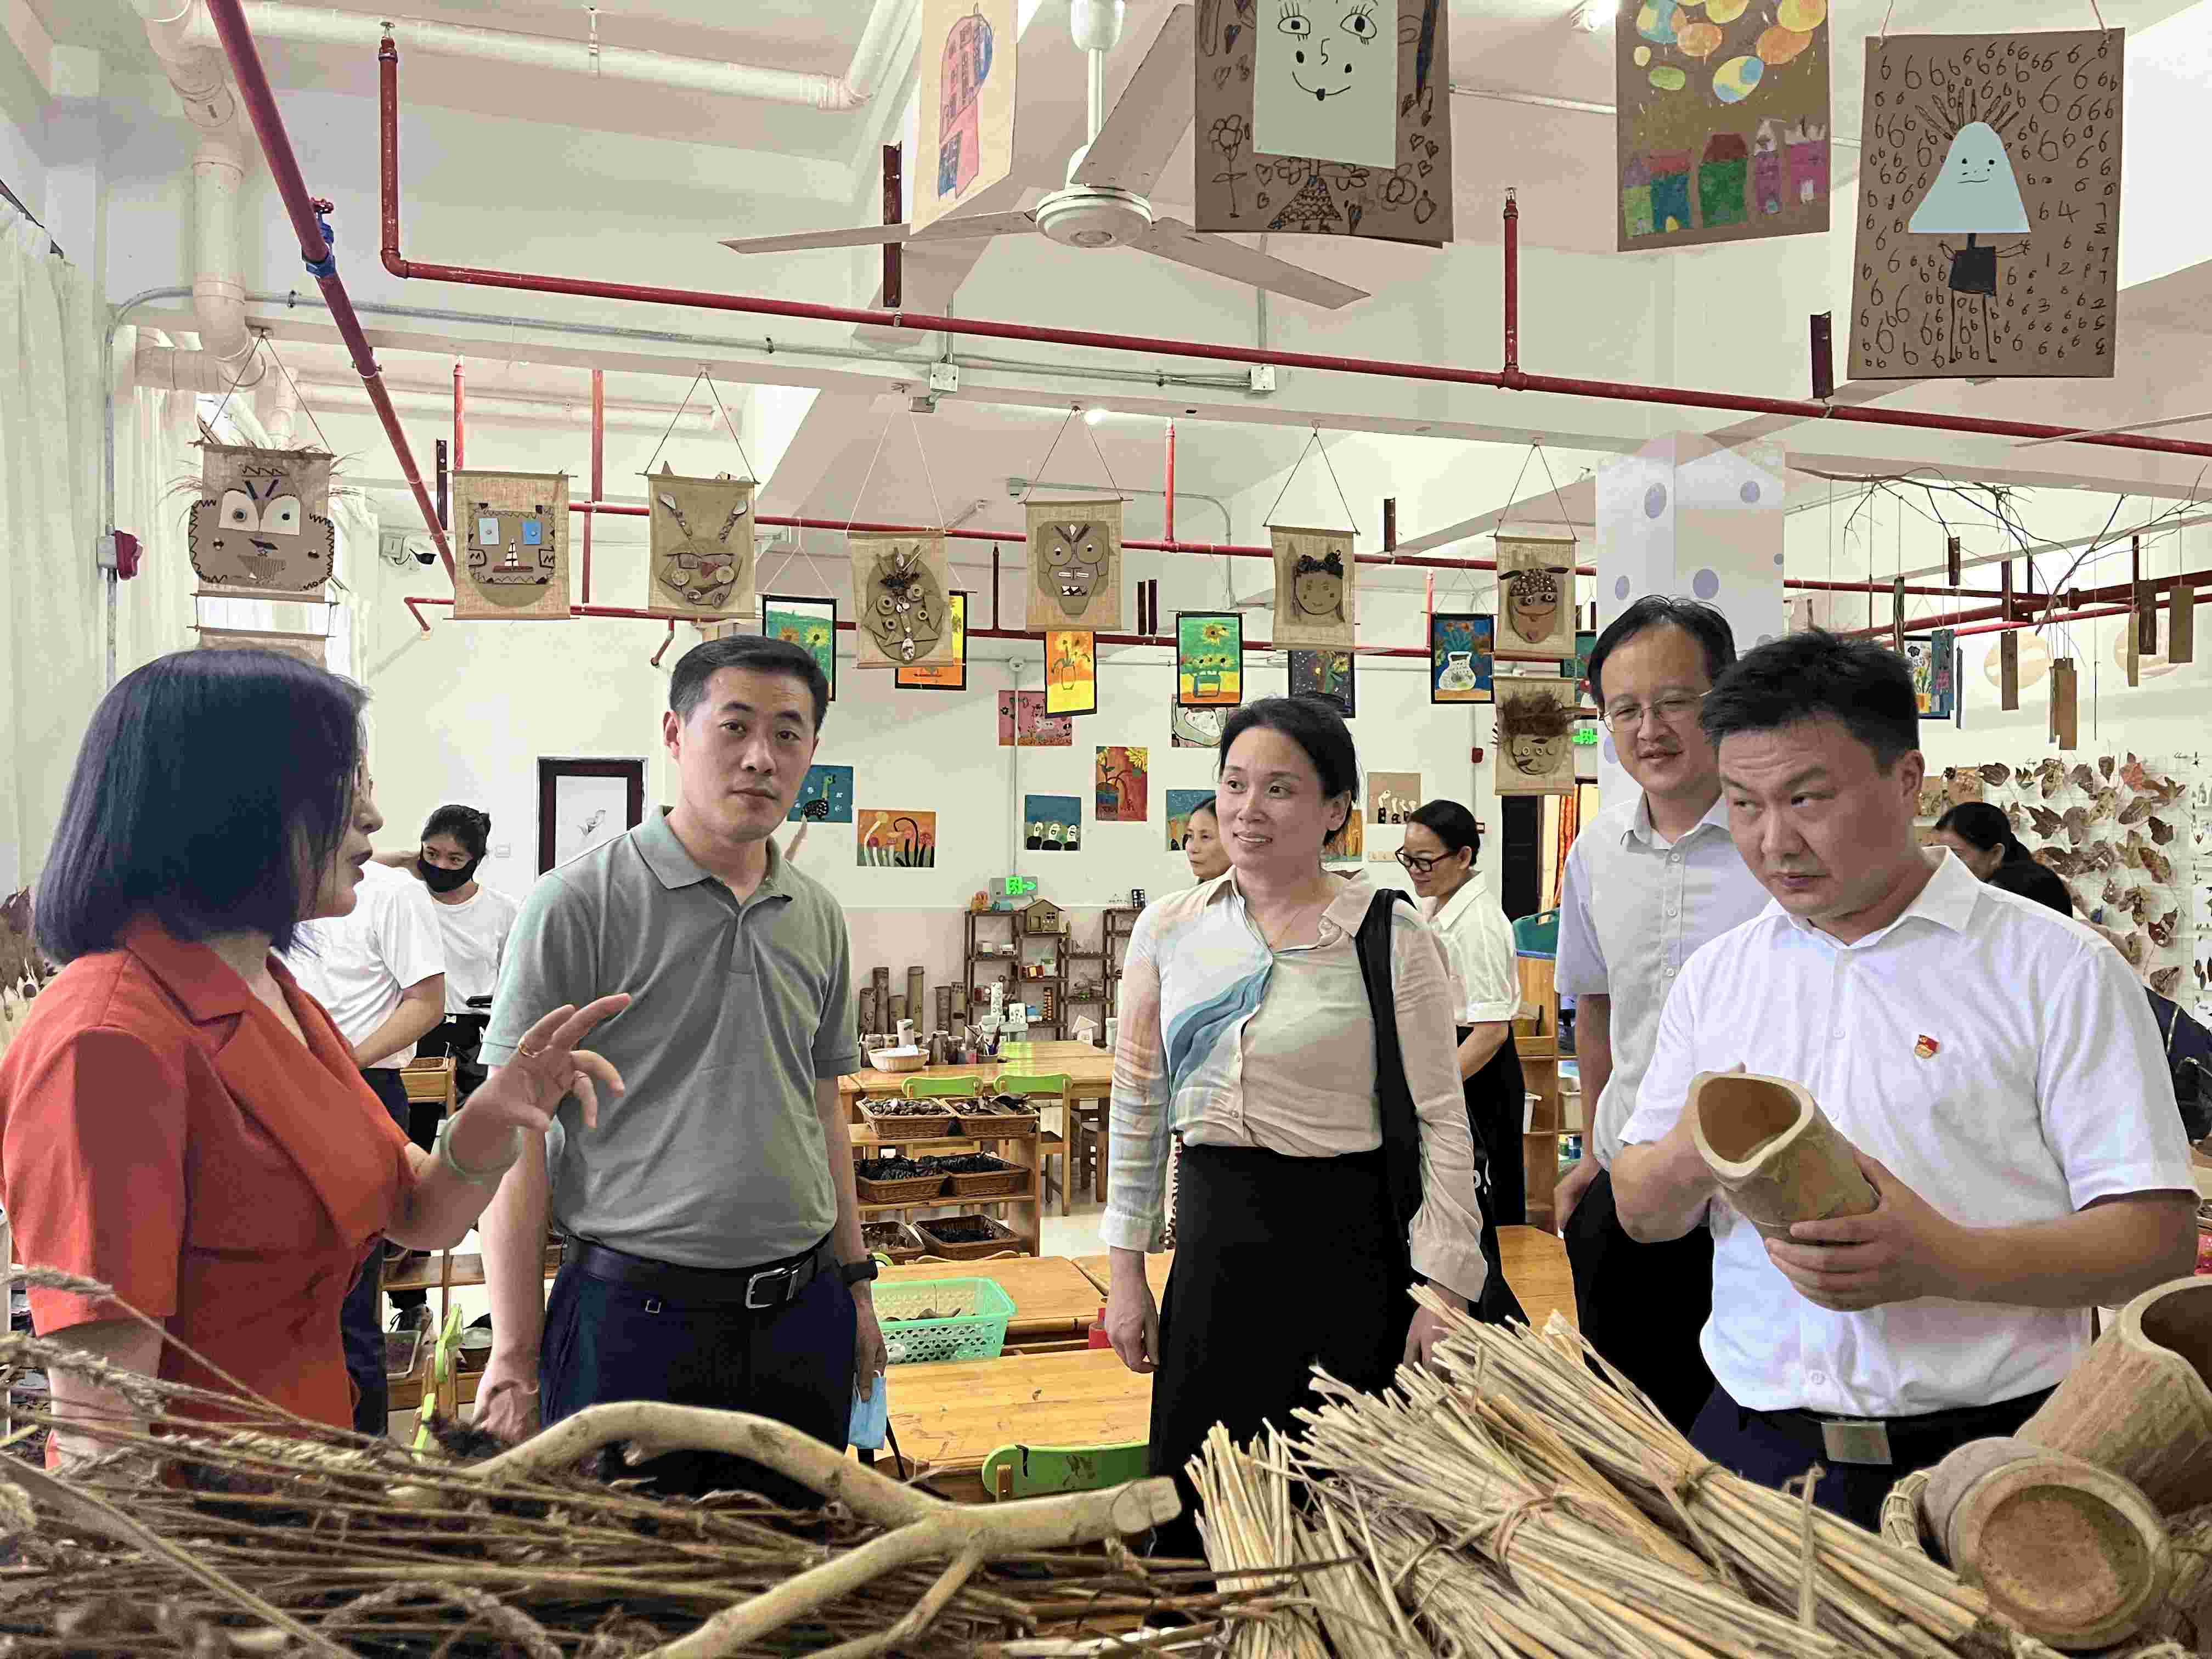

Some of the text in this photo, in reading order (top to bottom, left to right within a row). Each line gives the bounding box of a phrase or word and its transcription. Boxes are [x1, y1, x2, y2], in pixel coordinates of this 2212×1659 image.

[1963, 48, 1975, 65] 6
[1985, 42, 1997, 59] 6
[2007, 41, 2015, 57] 6
[2018, 46, 2029, 61] 6
[2067, 44, 2082, 64] 6
[2098, 40, 2107, 59] 6
[1881, 55, 1892, 80] 6
[1948, 59, 1961, 76] 6
[1977, 59, 1989, 75] 6
[1997, 58, 2006, 76] 6
[2032, 54, 2040, 69] 6
[2041, 50, 2059, 72] 6
[1905, 55, 1922, 89] 6
[1929, 57, 1945, 86] 6
[2074, 58, 2096, 89] 6
[2098, 71, 2108, 87] 6
[1981, 80, 1993, 99] 6
[2038, 75, 2062, 114] 6
[1875, 91, 1884, 106] 6
[2067, 94, 2088, 121] 6
[2088, 98, 2101, 120] 6
[2104, 99, 2113, 119] 6
[1875, 114, 1884, 138] 6
[1888, 114, 1905, 148] 6
[1905, 114, 1916, 132] 6
[2029, 114, 2038, 133] 6
[2018, 126, 2027, 140] 6
[2063, 127, 2076, 149] 6
[2098, 130, 2109, 153] 6
[1878, 147, 1885, 158] 6
[1917, 138, 1932, 167] 6
[2022, 145, 2032, 160] 6
[2038, 130, 2058, 162] 6
[1893, 152, 1901, 167] 6
[2076, 145, 2094, 168] 6
[1878, 163, 1892, 184] 6
[2100, 157, 2111, 176] 6
[1896, 167, 1908, 184] 6
[1917, 172, 1926, 189] 6
[2028, 174, 2035, 184] 6
[2075, 178, 2089, 191] 6
[1902, 184, 1914, 204] 6
[2039, 202, 2050, 221] 6
[2058, 200, 2080, 223] 4
[1866, 213, 1874, 230] 6
[1876, 225, 1887, 250] 6
[2063, 235, 2072, 249] 6
[2086, 241, 2094, 251] 6
[1910, 255, 1917, 268] 6
[1928, 255, 1935, 267] 6
[2058, 262, 2074, 275] 2
[1863, 263, 1872, 281] 6
[1920, 267, 1930, 283] 6
[1938, 264, 1946, 281] 6
[2006, 267, 2016, 285] 6
[1871, 278, 1883, 306] 6
[1936, 286, 1944, 304] 6
[2061, 286, 2068, 294] 6
[1896, 284, 1910, 323] 6
[1969, 298, 1978, 314] 6
[2006, 292, 2014, 307] 6
[2038, 298, 2050, 313] 3
[2076, 292, 2085, 306] 6
[2090, 298, 2107, 309] 2
[1861, 308, 1869, 327] 6
[1936, 307, 1943, 323] 6
[1990, 307, 1999, 320] 6
[2022, 303, 2030, 316] 6
[2064, 310, 2072, 319] 6
[1920, 312, 1932, 346] 6
[1960, 316, 1972, 344] 6
[2028, 319, 2035, 330] 6
[1875, 318, 1894, 354] 6
[1936, 328, 1944, 341] 6
[1994, 330, 2001, 344] 6
[2012, 334, 2023, 351] 6
[1863, 338, 1871, 351] 6
[2038, 341, 2048, 354] 6
[2058, 346, 2064, 358] 6
[1877, 357, 1887, 368] 6
[1903, 342, 1918, 366] 6
